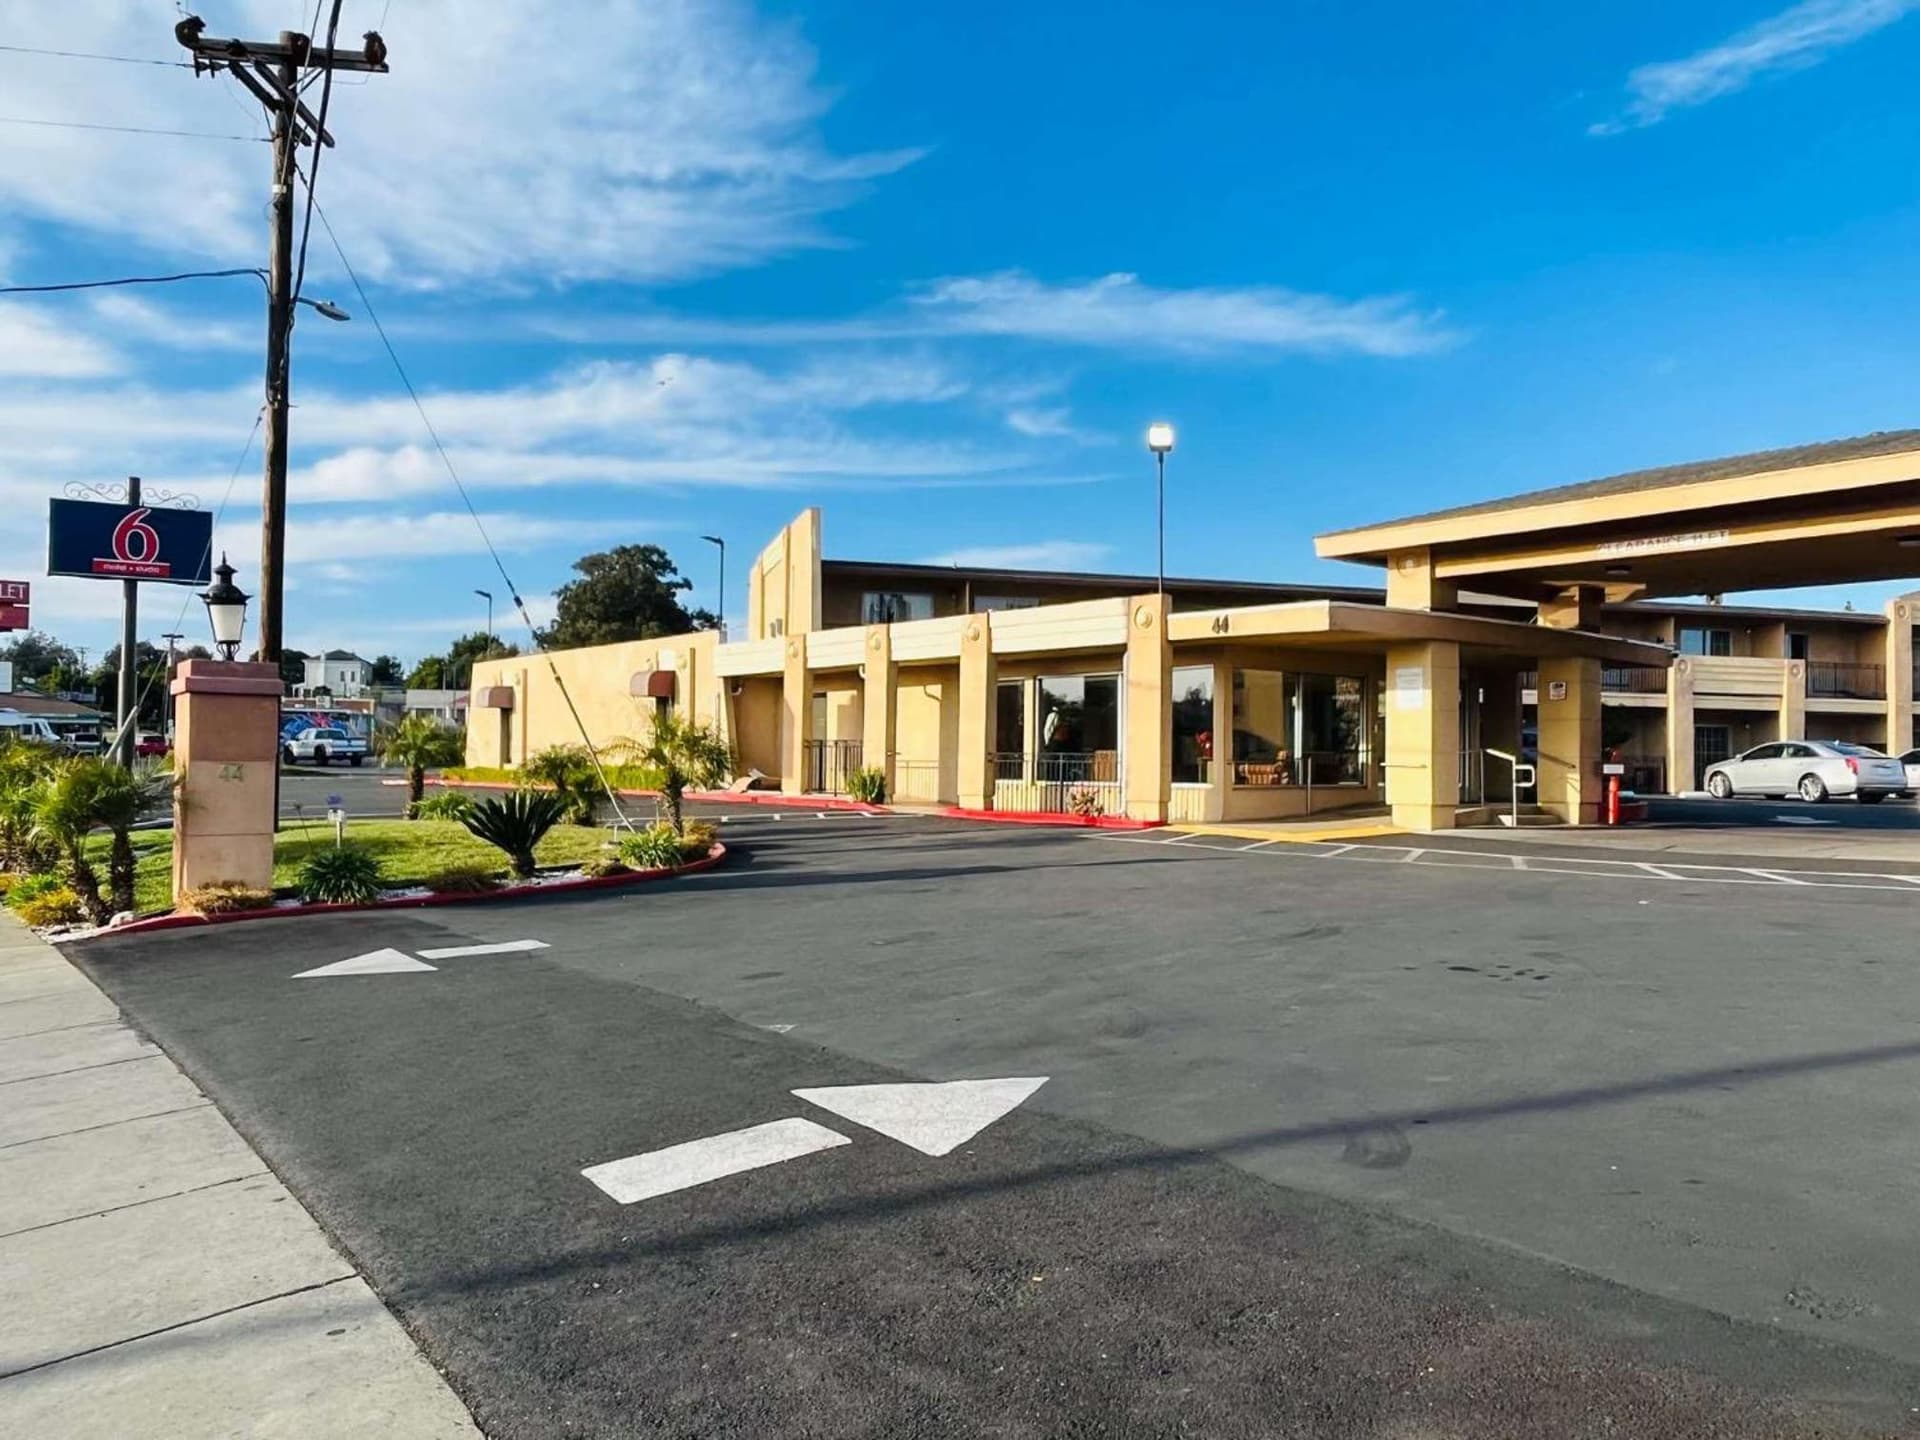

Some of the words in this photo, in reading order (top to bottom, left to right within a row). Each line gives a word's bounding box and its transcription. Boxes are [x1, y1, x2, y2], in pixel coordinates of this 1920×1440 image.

[112, 507, 160, 563] 6
[1211, 615, 1230, 634] 44
[217, 763, 245, 782] 44
